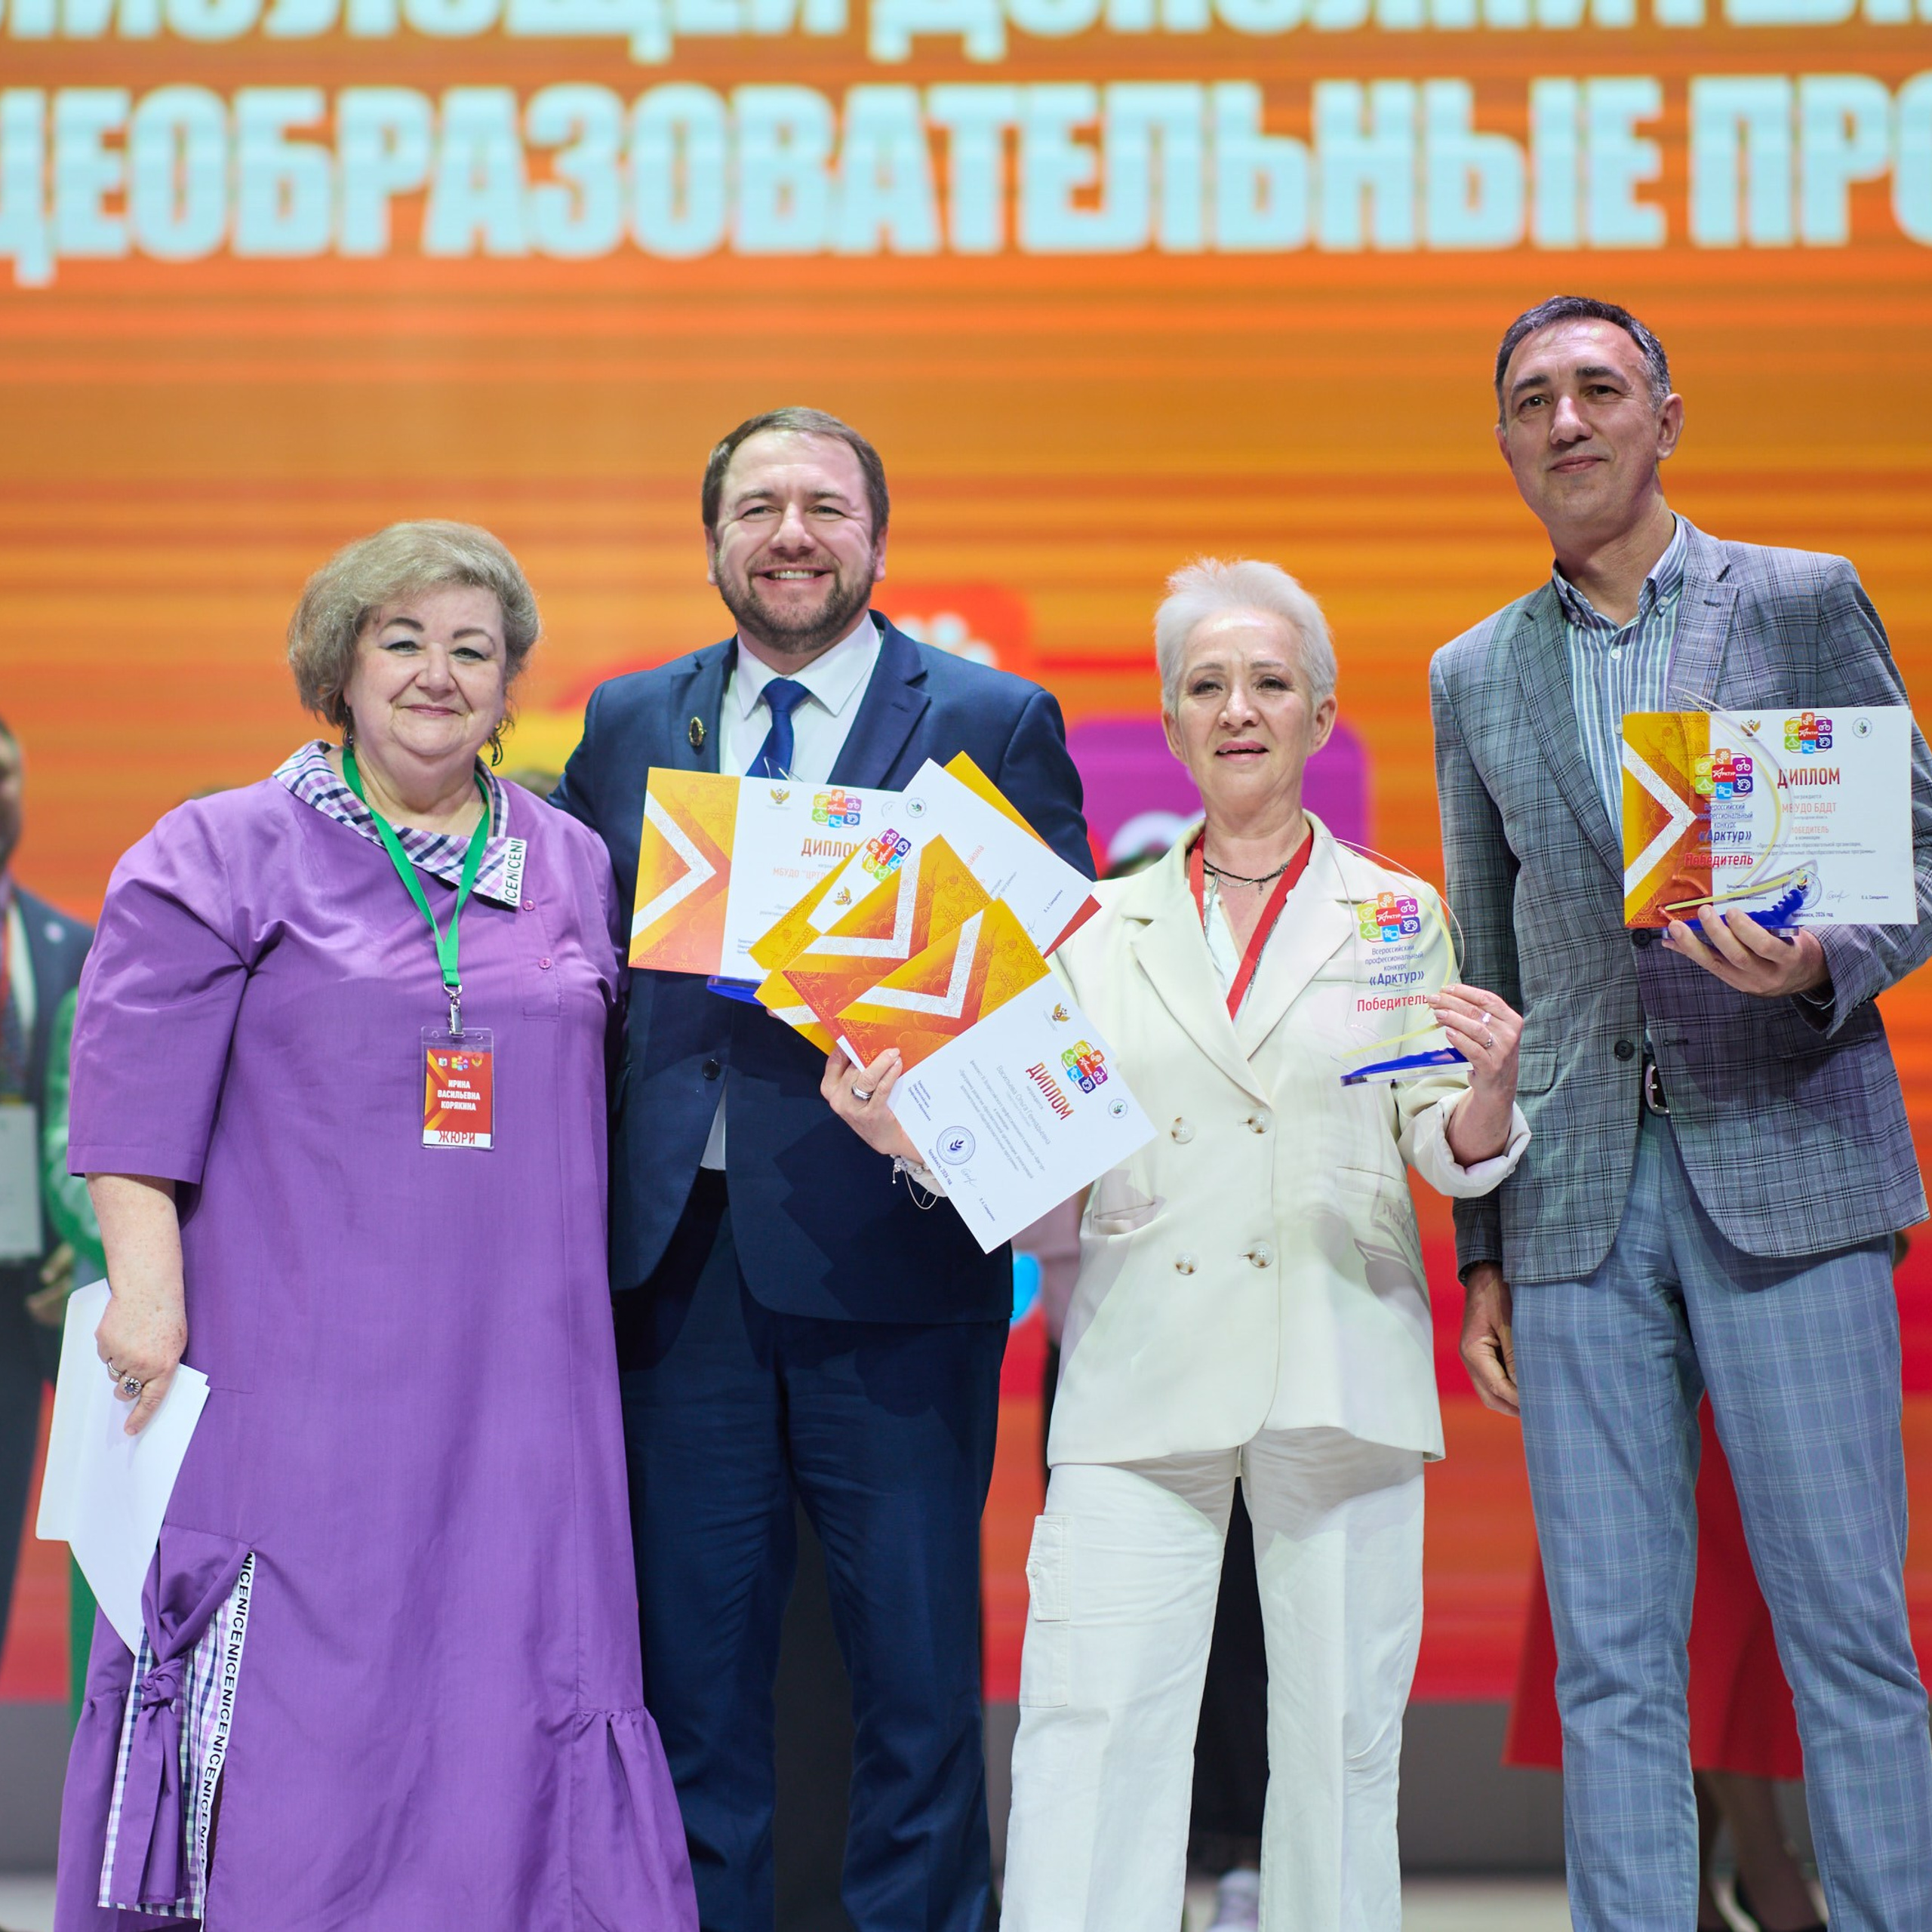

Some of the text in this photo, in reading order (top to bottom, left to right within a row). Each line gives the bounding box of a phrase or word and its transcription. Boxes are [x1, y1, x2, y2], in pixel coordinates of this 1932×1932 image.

[1777, 768, 1840, 789] ДИПЛОМ
[1699, 829, 1752, 843] «Арктур»
[801, 838, 858, 857] ДИПЛО
[1684, 853, 1753, 868] Победитель
[1371, 944, 1414, 955] Всероссийский
[1364, 952, 1424, 964] профессиональный
[1369, 971, 1425, 986] «Арктур»
[1357, 995, 1428, 1012] Победитель
[448, 1079, 471, 1089] ИРИНА
[1026, 1061, 1074, 1121] ДИПЛОМ
[437, 1090, 481, 1100] ВАСИЛЬЕВНА
[441, 1101, 476, 1111] КОРЯКИНА
[438, 1131, 475, 1144] ЖЮРИ
